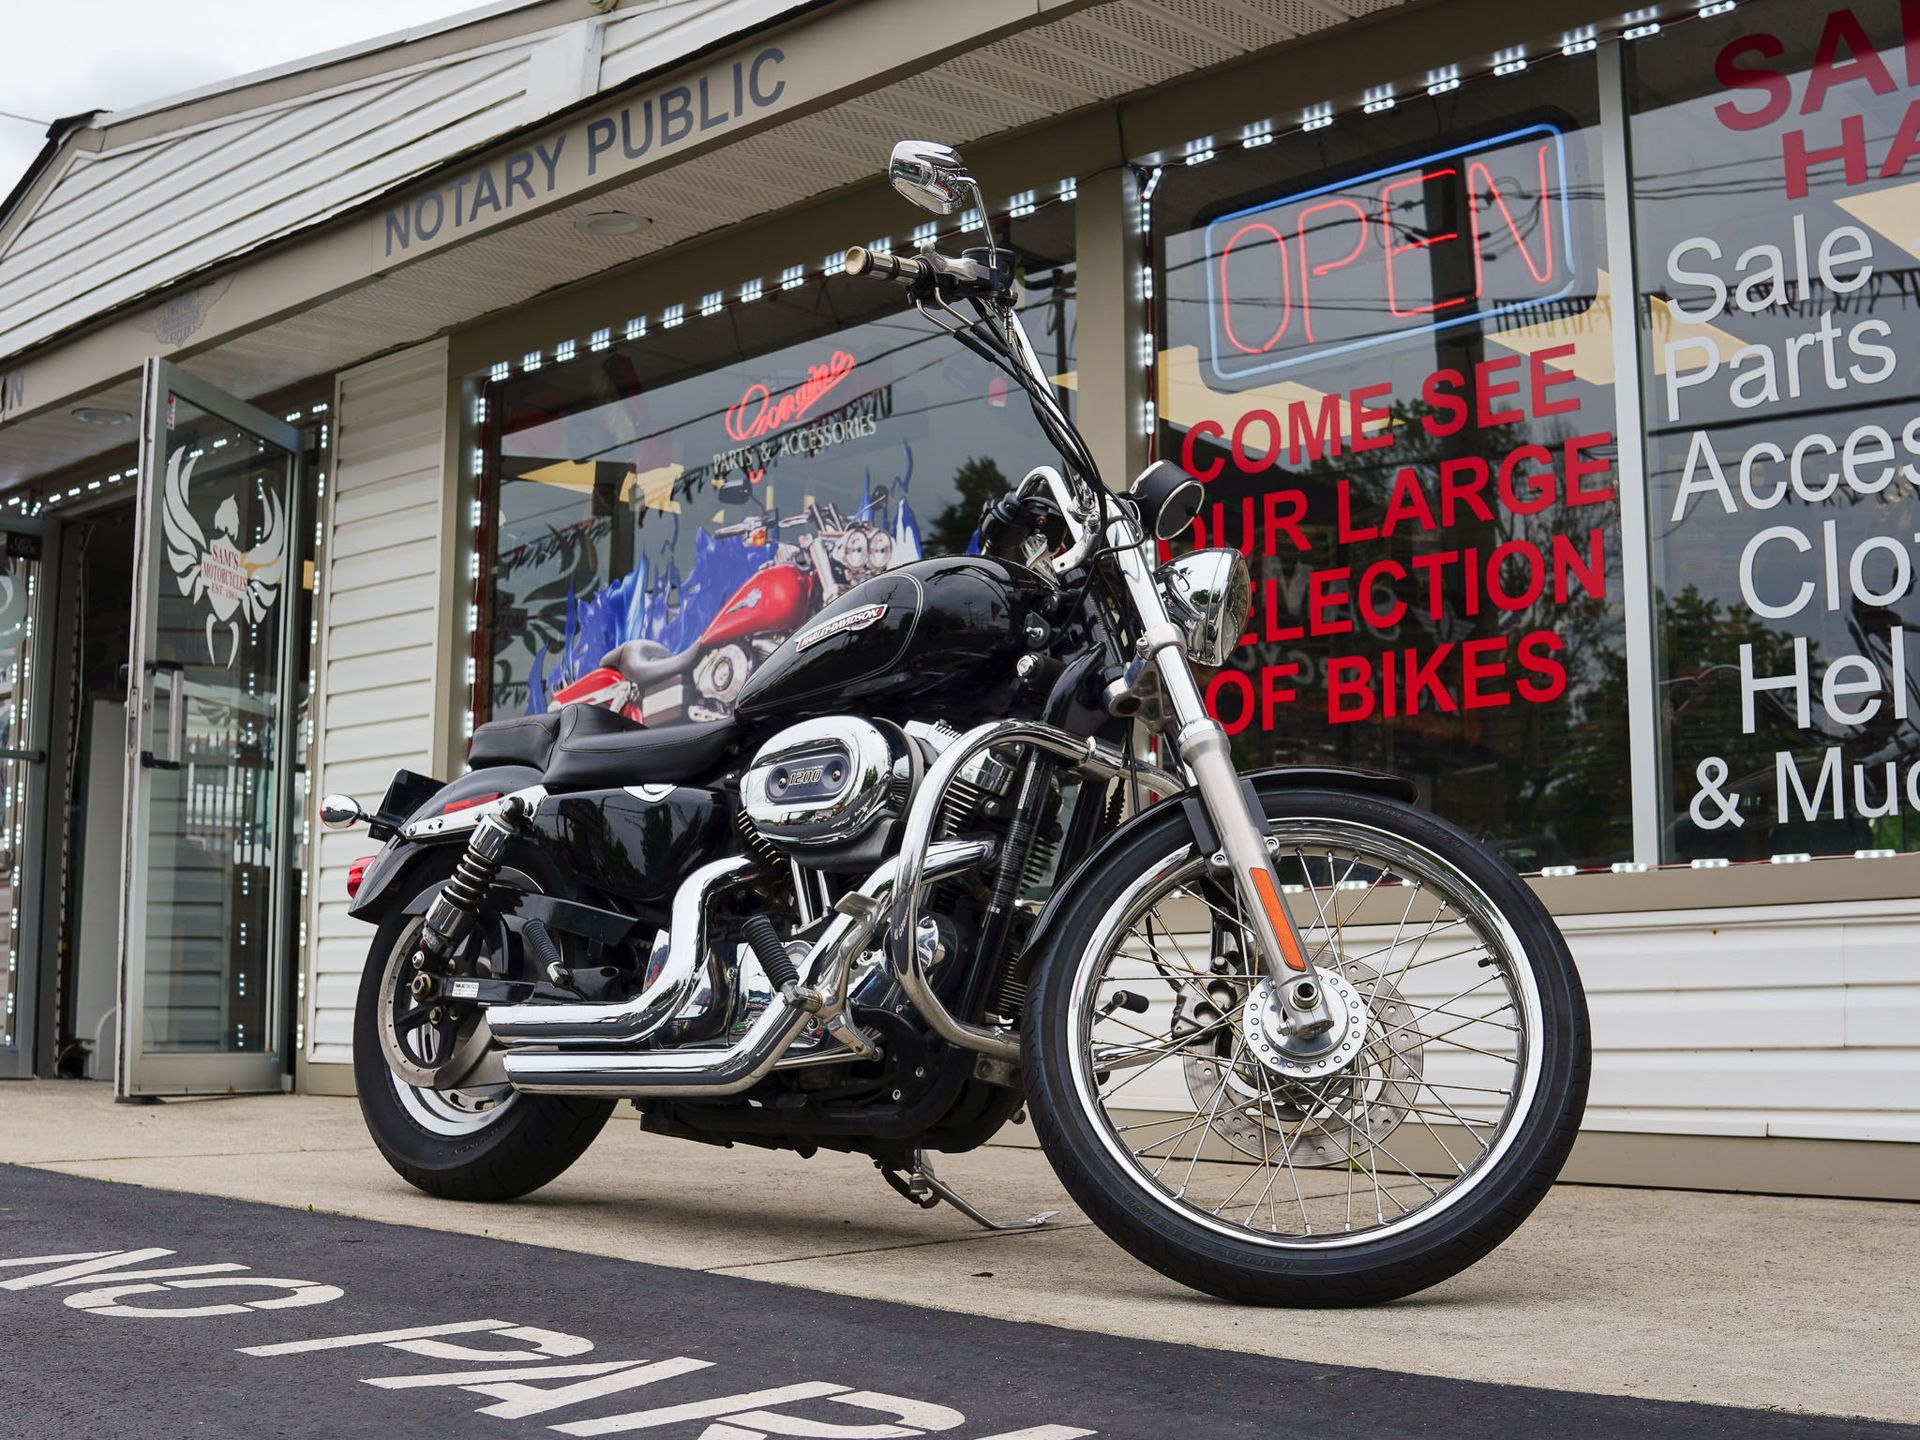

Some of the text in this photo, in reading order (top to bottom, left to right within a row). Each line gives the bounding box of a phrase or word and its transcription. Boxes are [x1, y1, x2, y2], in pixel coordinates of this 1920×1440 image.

[1714, 0, 1920, 131] SA
[385, 47, 787, 257] NOTARY PUBLIC
[1220, 145, 1553, 355] OPEN
[1666, 214, 1874, 324] Sale
[0, 367, 25, 411] N
[1181, 343, 1580, 484] COME SEE
[1665, 310, 1897, 422] Parts
[713, 413, 877, 474] PARTS & ACCESSORIES
[1337, 431, 1616, 546] LARGE
[212, 544, 239, 571] SAM'S
[1237, 528, 1606, 647] LECTION
[1739, 520, 1920, 619] Clo
[801, 607, 879, 646] HARLEY-DAVIDSON
[1739, 625, 1908, 734] Hel
[1204, 663, 1299, 736] OF
[1327, 630, 1568, 725] BIKES
[788, 767, 823, 786] 1200
[1689, 756, 1746, 830] &
[0, 1247, 345, 1318] NO
[235, 1318, 1098, 1440] PAR
